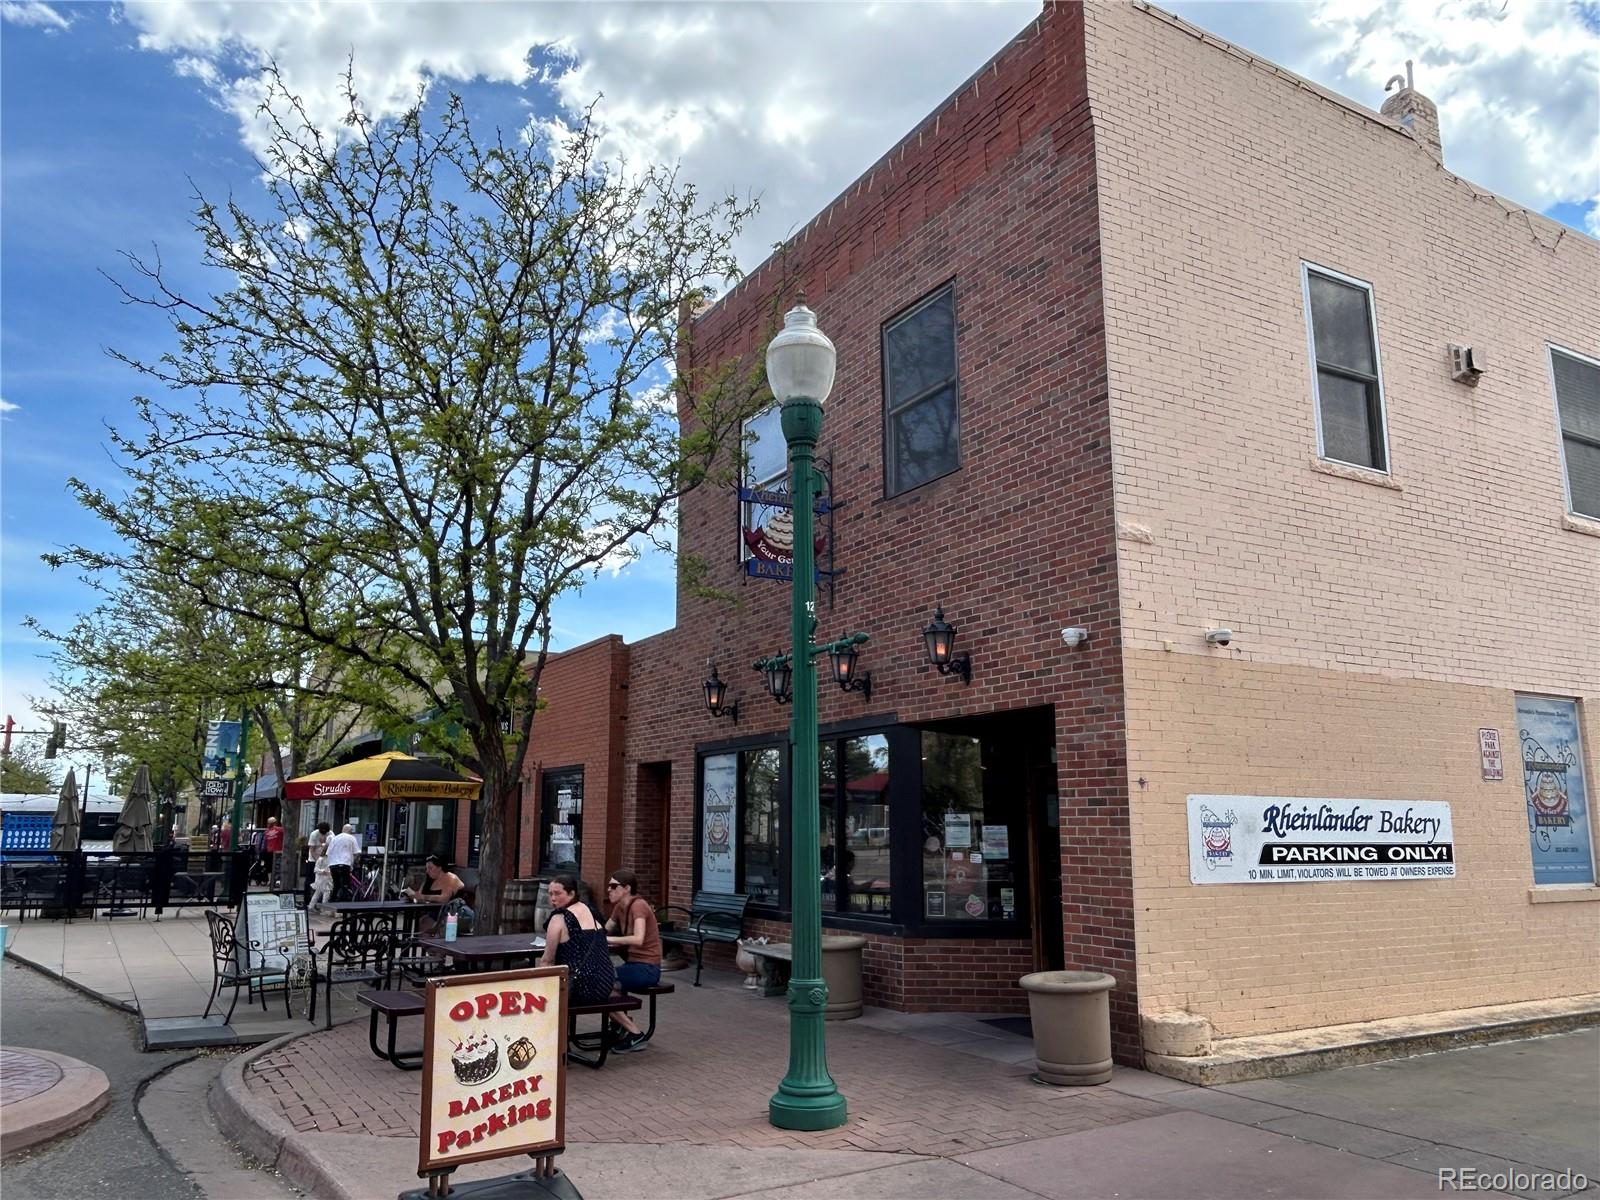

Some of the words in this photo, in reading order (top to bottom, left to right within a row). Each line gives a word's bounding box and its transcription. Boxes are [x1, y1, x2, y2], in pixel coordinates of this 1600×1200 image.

[758, 541, 776, 560] Your
[757, 562, 792, 576] BAKE
[203, 722, 220, 760] DINE
[1481, 731, 1496, 740] PLEASE
[1484, 741, 1496, 749] PARK
[1487, 759, 1496, 767] THE
[313, 783, 351, 796] Strudels
[444, 783, 474, 797] Bakery
[1261, 803, 1373, 838] Rheinländer
[1378, 808, 1441, 844] Bakery
[1538, 815, 1566, 825] BAKERY
[1272, 847, 1378, 861] PARKING
[1388, 847, 1447, 860] ONLY!
[1248, 869, 1257, 880] 10
[1260, 869, 1275, 879] MIN.
[1336, 868, 1352, 877] WILL
[1354, 868, 1363, 877] BE
[1365, 867, 1388, 877] TOWED
[1391, 867, 1398, 876] AT
[1400, 866, 1426, 877] OWNERS
[1428, 866, 1454, 876] EXPENSE
[449, 991, 547, 1021] OPEN
[449, 1075, 542, 1118] BAKERY
[437, 1098, 552, 1153] Parking
